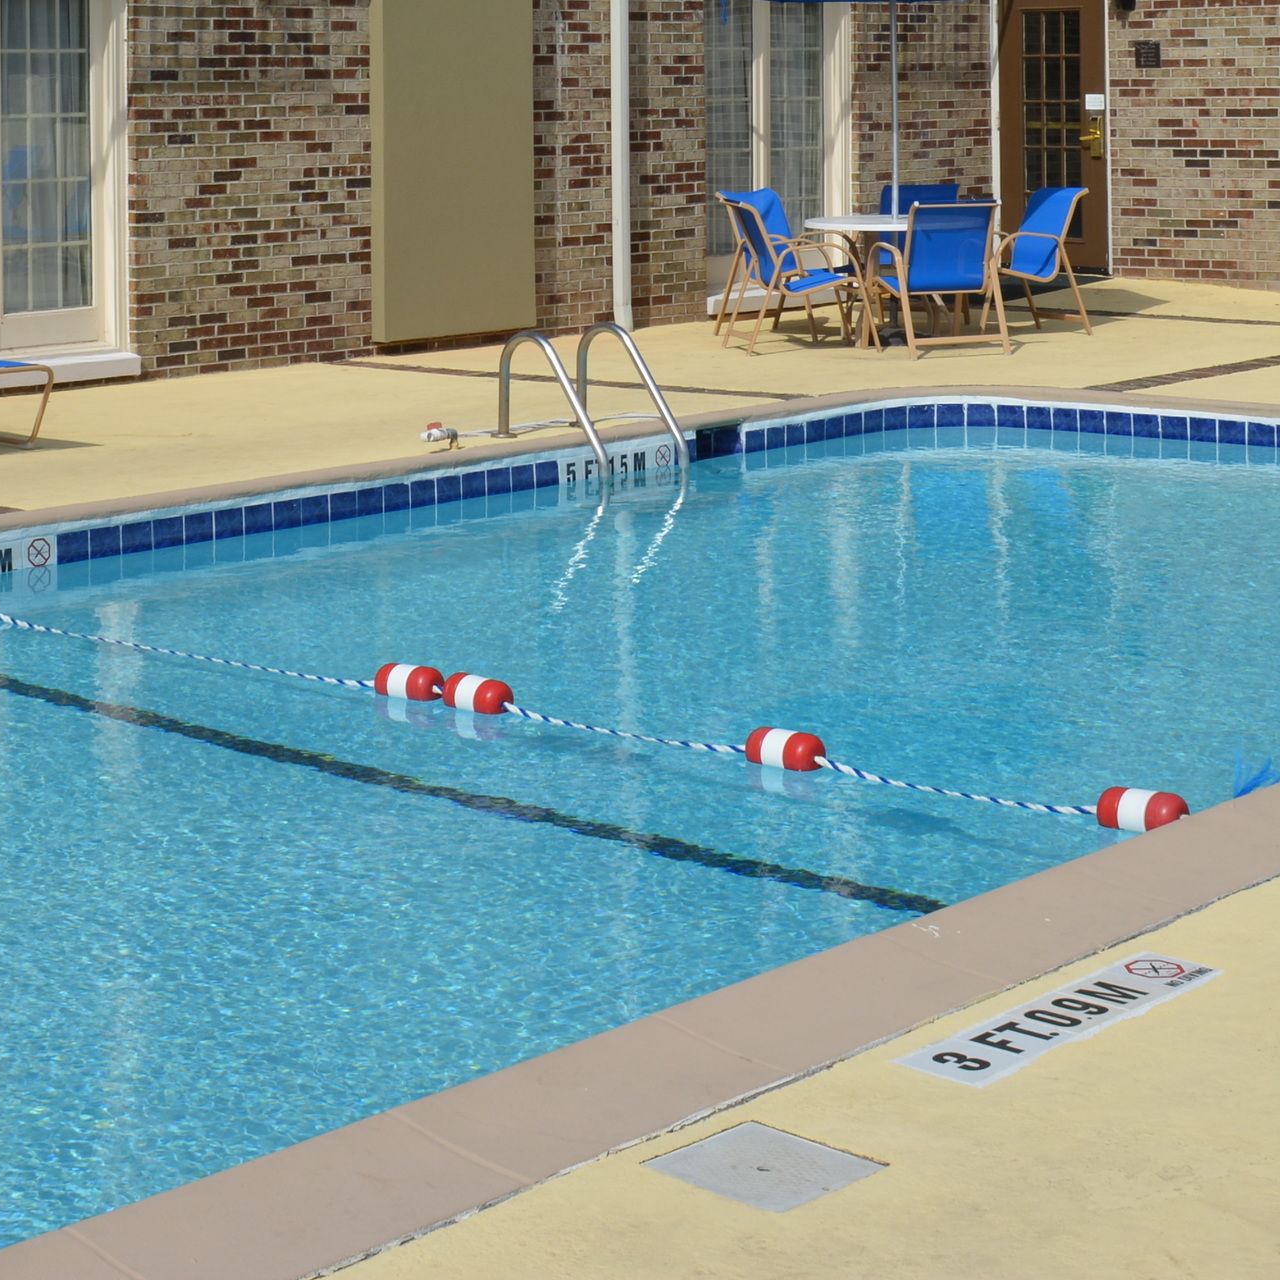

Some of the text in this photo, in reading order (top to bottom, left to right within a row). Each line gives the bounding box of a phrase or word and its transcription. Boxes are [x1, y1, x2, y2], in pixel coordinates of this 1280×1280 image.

[567, 462, 576, 483] 5
[634, 451, 646, 472] M
[932, 1051, 992, 1072] 3
[1074, 980, 1150, 1005] M
